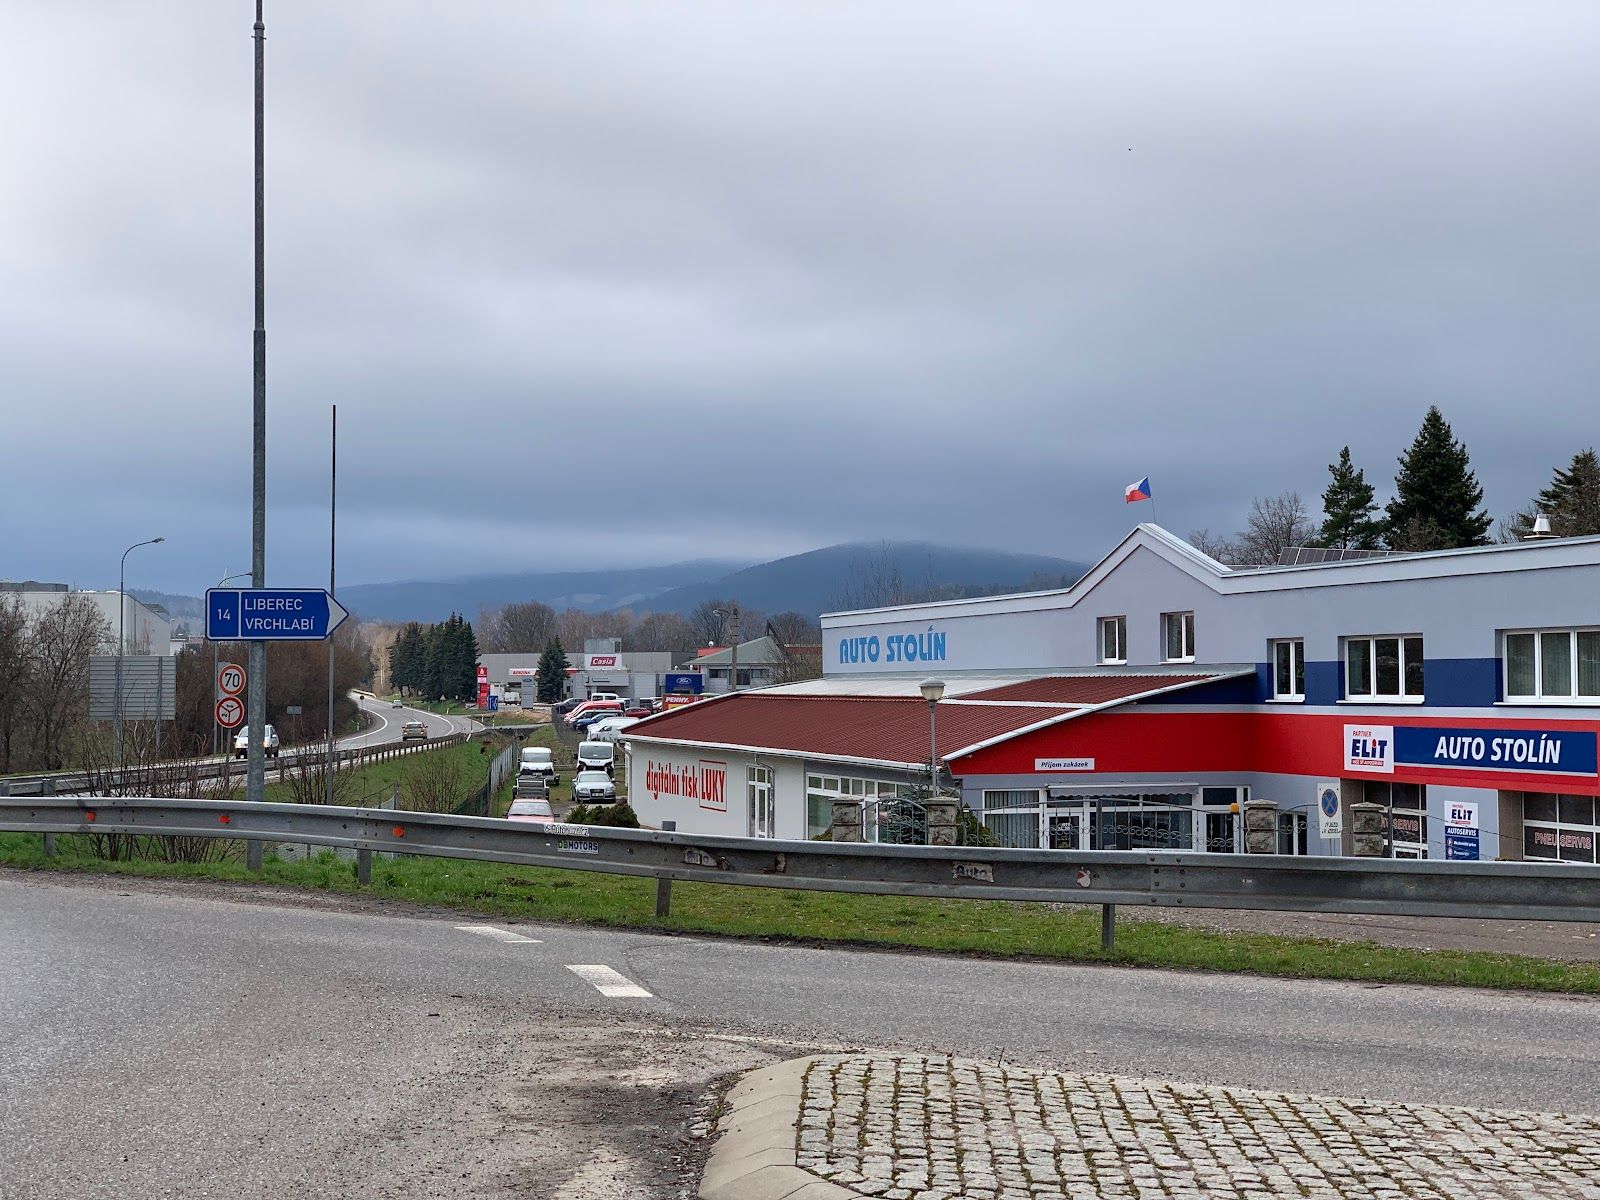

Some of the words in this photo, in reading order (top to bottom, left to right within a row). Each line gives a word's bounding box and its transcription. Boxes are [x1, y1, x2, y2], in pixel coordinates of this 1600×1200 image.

[244, 598, 303, 610] LIBEREC
[217, 608, 231, 620] 14
[245, 616, 315, 630] VRCHLABÍ
[840, 635, 880, 664] AUTO
[886, 625, 946, 662] STOLÍN
[592, 657, 613, 665] Casia
[225, 672, 240, 687] 70
[1434, 736, 1486, 760] AUTO
[1490, 733, 1561, 764] STOLÍN
[646, 760, 680, 800] digitální
[681, 764, 699, 799] tisk
[701, 768, 726, 803] LUKY
[1392, 818, 1419, 832] SERVIS
[1447, 827, 1477, 837] AUTOSERVIS
[1534, 832, 1558, 847] PNEU
[1560, 834, 1592, 850] SERVIS
